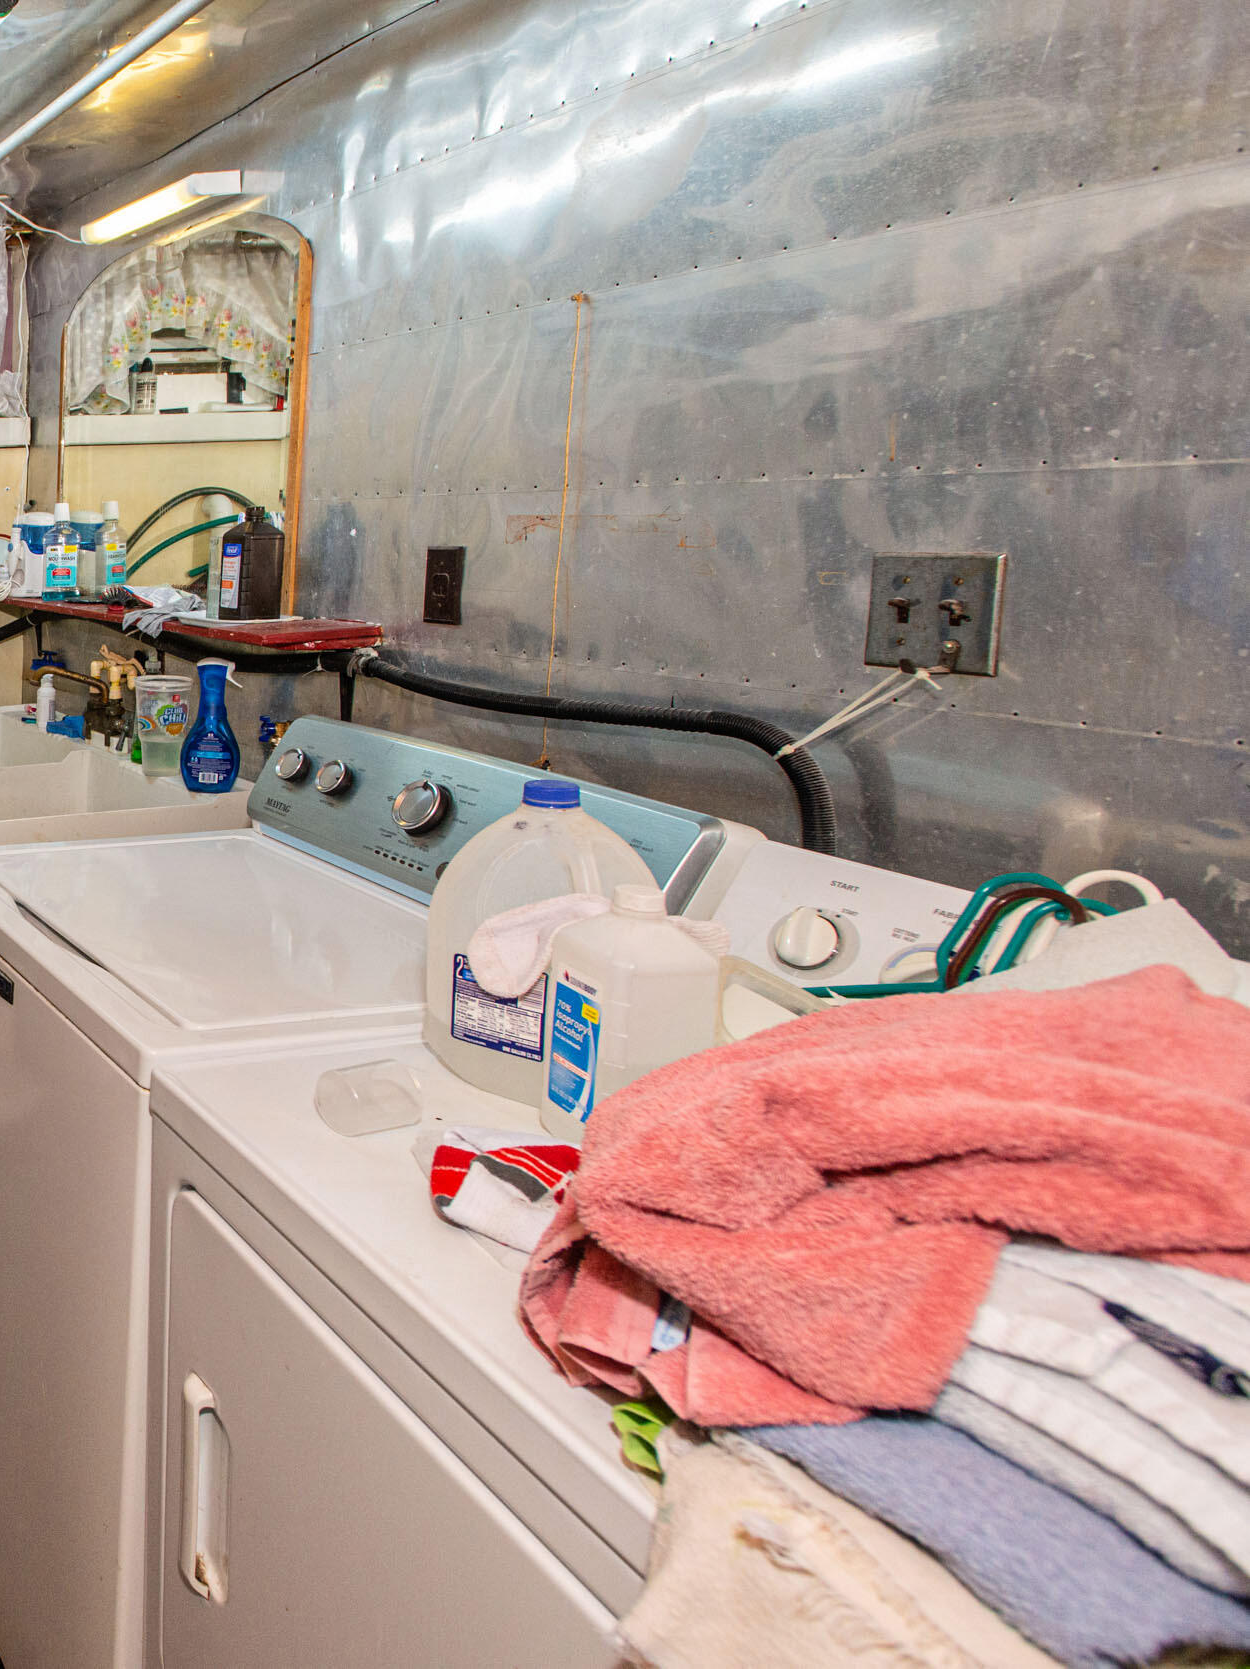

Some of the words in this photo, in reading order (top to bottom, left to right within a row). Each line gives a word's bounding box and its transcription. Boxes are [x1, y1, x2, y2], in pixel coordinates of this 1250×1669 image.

[266, 797, 292, 813] MAYTAG
[830, 880, 860, 892] START
[456, 956, 464, 978] 2
[557, 999, 572, 1013] 70%
[555, 1020, 584, 1043] Alcohol
